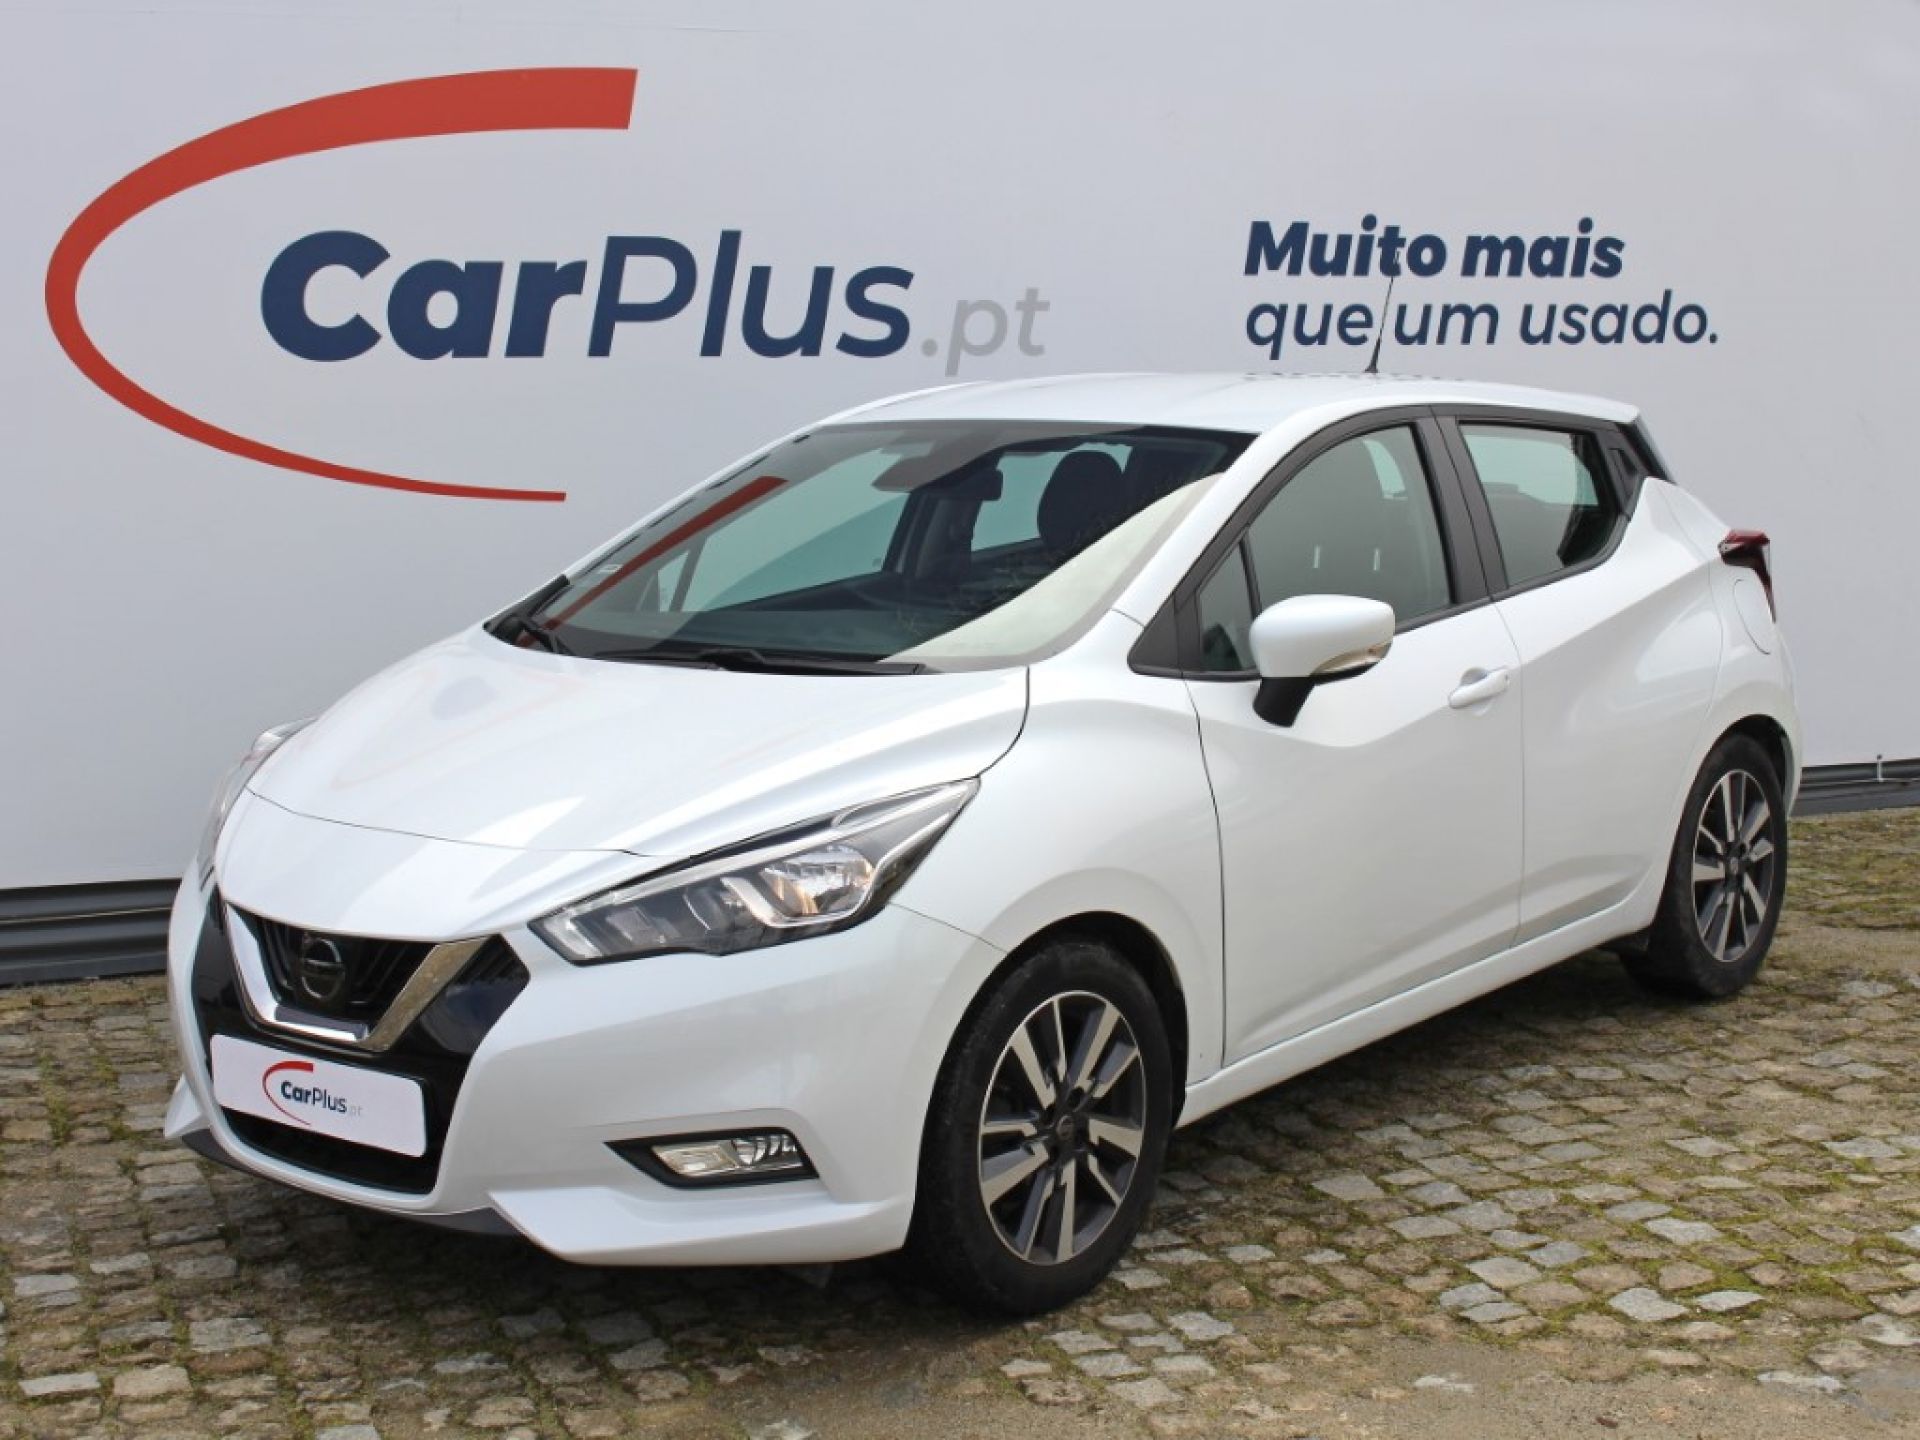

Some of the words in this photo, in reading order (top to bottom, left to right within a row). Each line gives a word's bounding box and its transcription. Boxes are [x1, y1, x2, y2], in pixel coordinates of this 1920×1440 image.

[1244, 213, 1447, 278] Muito
[1460, 216, 1625, 278] mais
[261, 229, 1051, 376] CarPlus.pt
[1246, 303, 1374, 361] que
[1394, 303, 1499, 346] um
[1519, 288, 1718, 346] usado.
